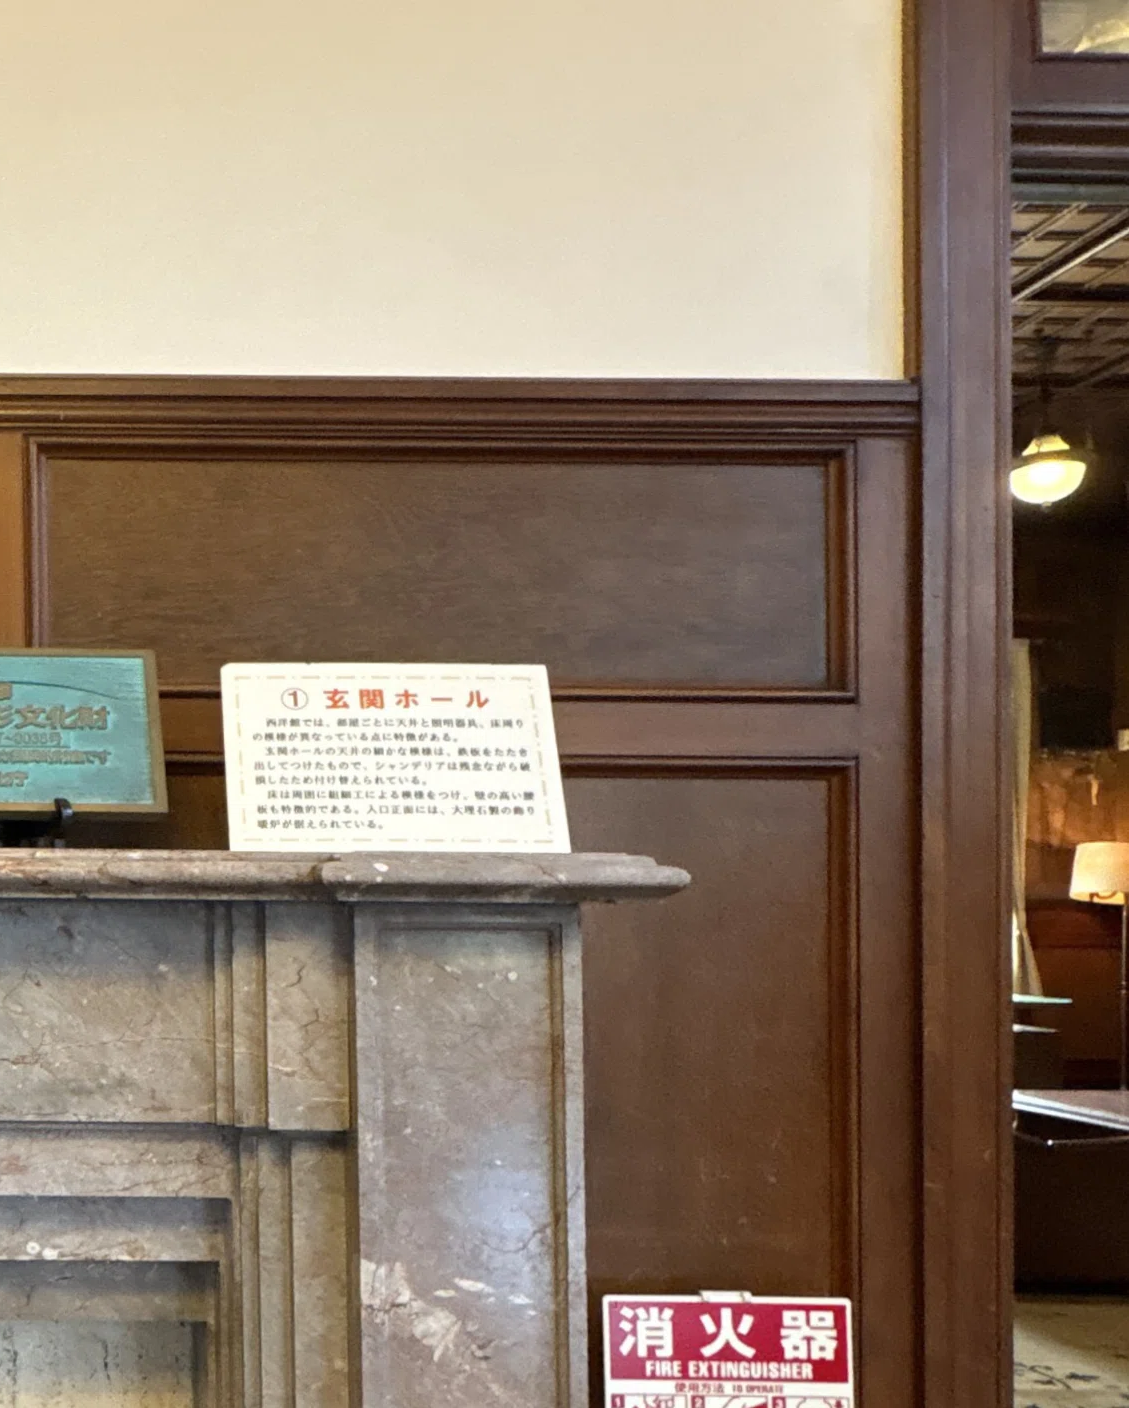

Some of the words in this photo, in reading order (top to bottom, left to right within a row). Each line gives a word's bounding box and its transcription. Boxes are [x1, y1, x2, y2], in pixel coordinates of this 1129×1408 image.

[323, 688, 489, 709] 玄関ホール
[618, 1306, 838, 1361] 消火器
[645, 1360, 683, 1378] FIRE
[688, 1361, 814, 1379] EXTINGUISHER
[674, 1382, 725, 1393] 使用方法
